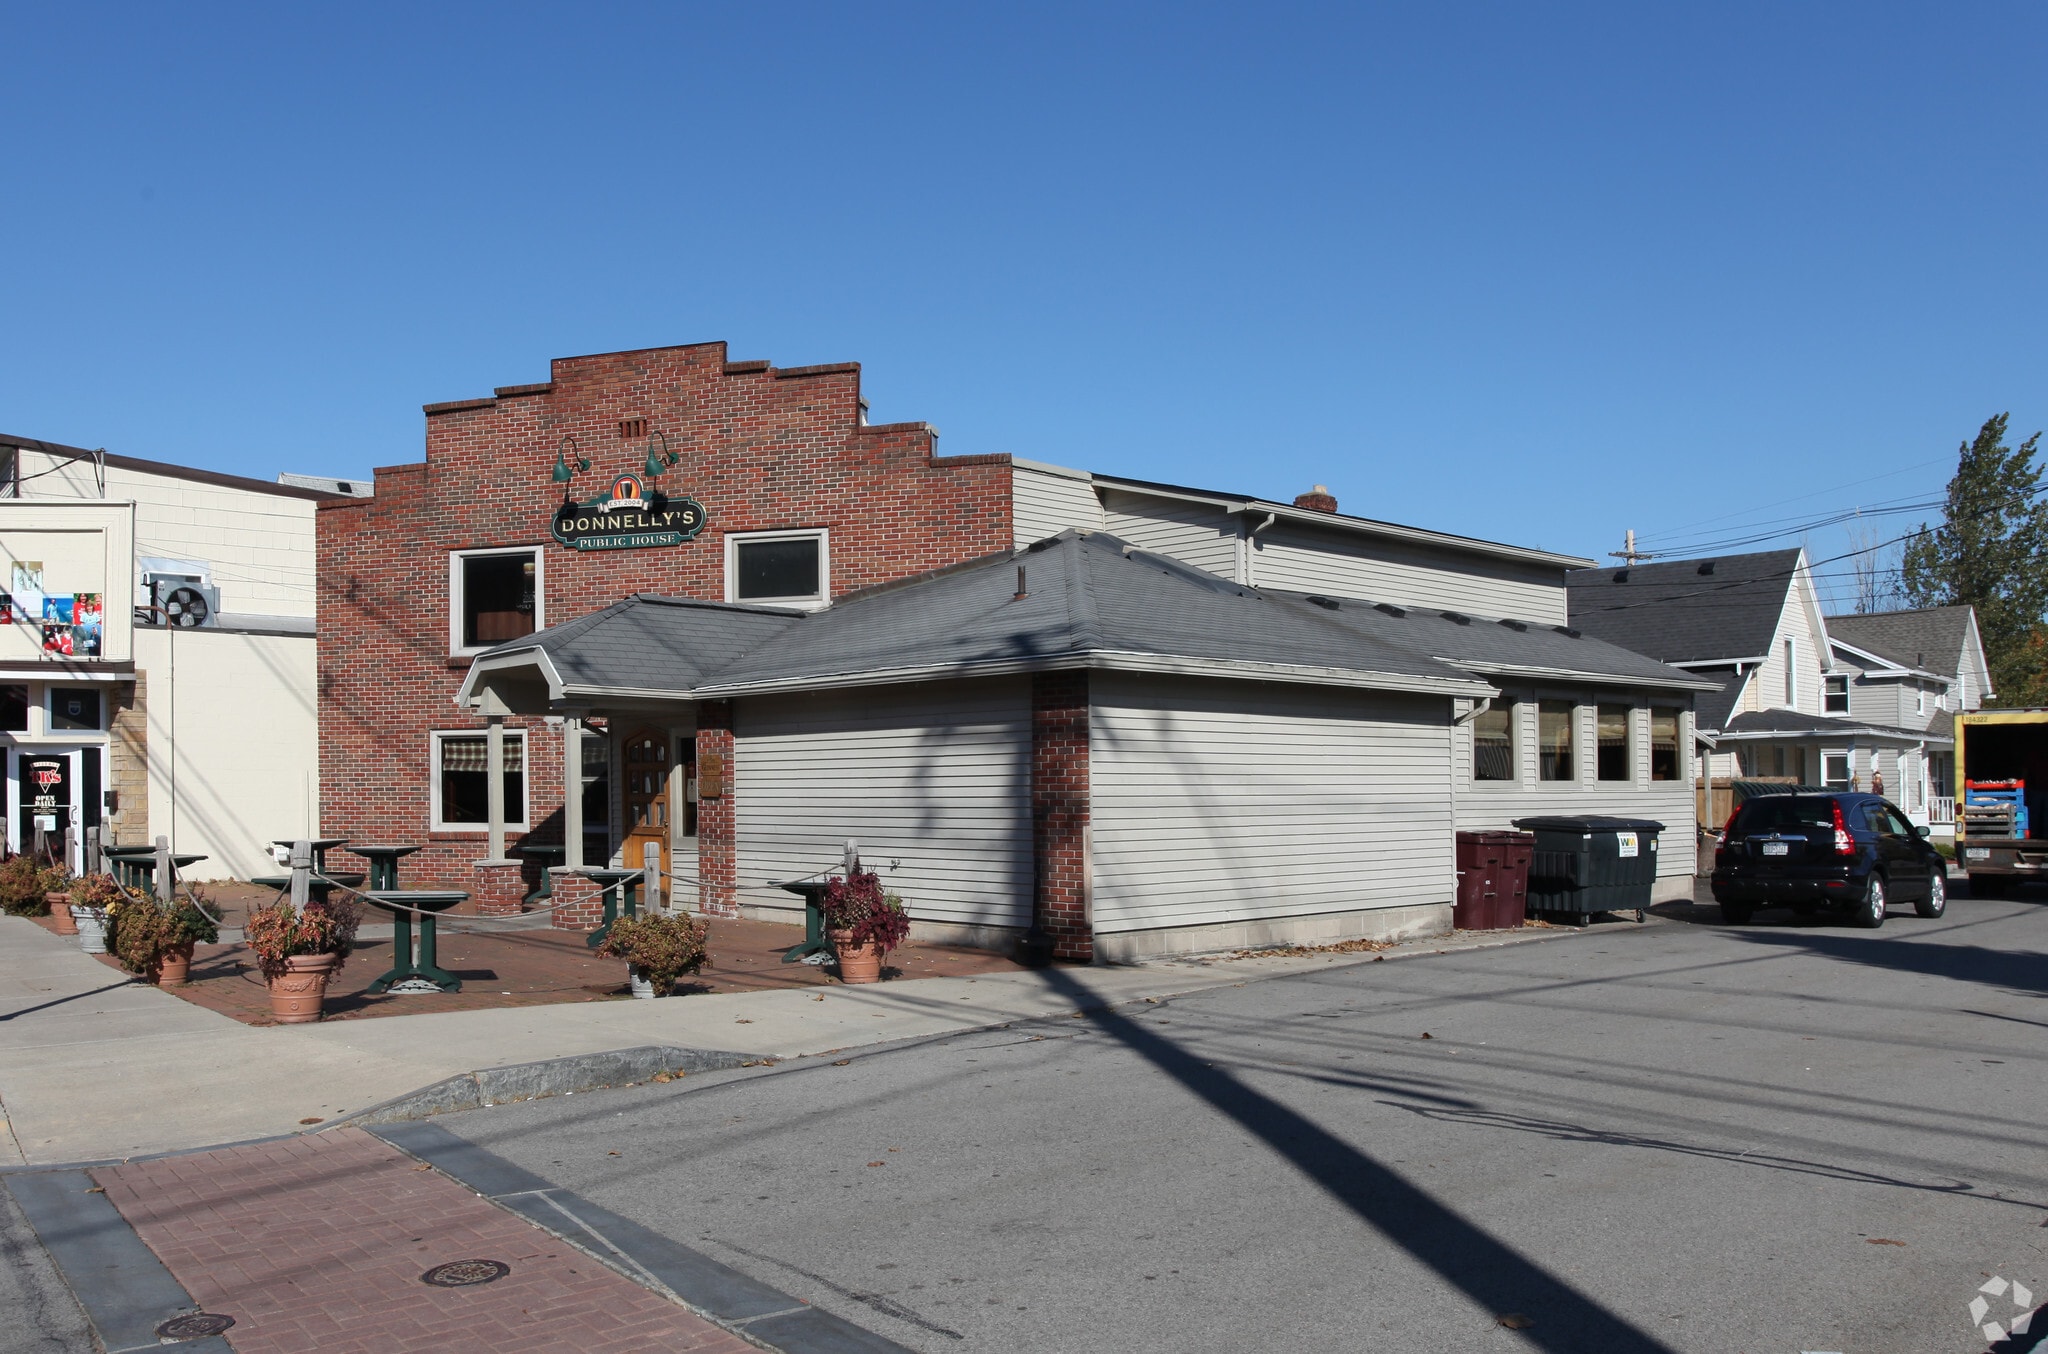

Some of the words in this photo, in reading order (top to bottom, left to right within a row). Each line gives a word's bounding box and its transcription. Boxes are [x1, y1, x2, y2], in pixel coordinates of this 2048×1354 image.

[562, 511, 694, 532] DONNELLY'S
[579, 537, 626, 548] PUBLIC
[631, 534, 676, 546] HOUSE
